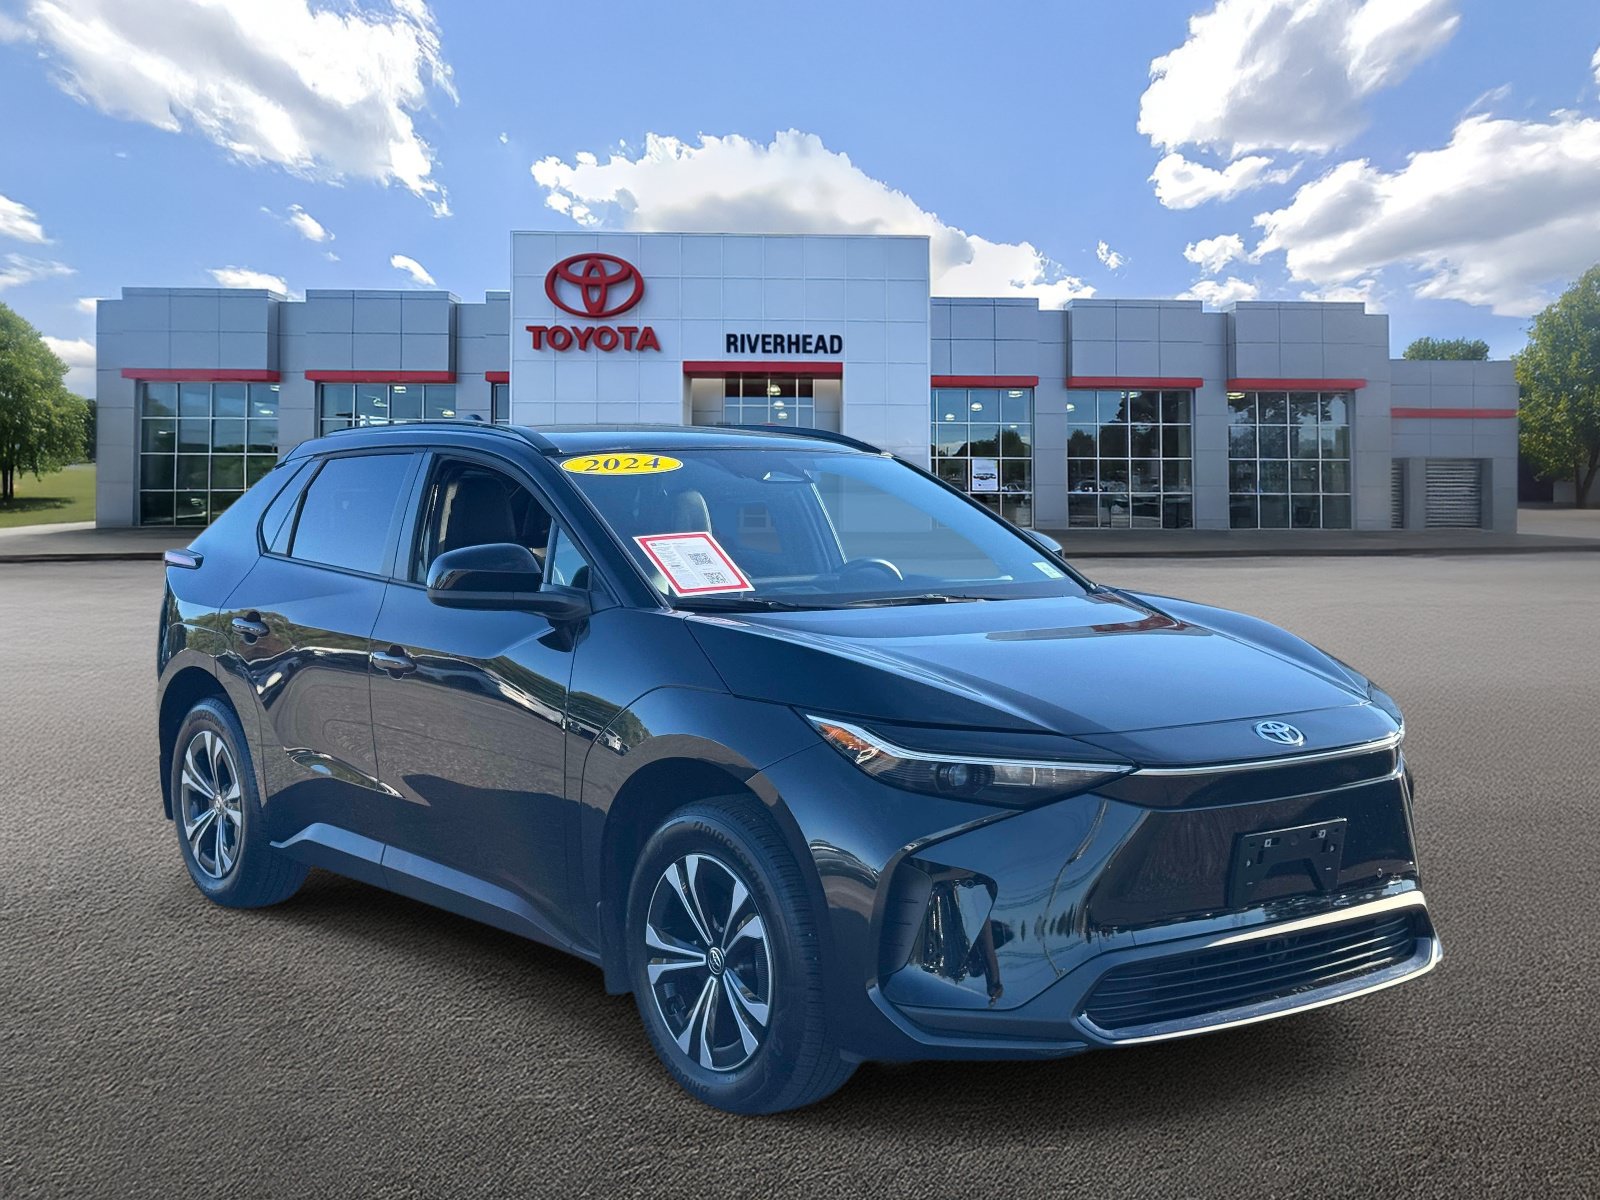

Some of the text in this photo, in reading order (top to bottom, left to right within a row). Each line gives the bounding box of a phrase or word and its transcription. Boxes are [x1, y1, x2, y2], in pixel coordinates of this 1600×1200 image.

[526, 326, 661, 352] TOYOTA
[726, 334, 843, 354] RIVERHEAD
[583, 457, 661, 472] 2024
